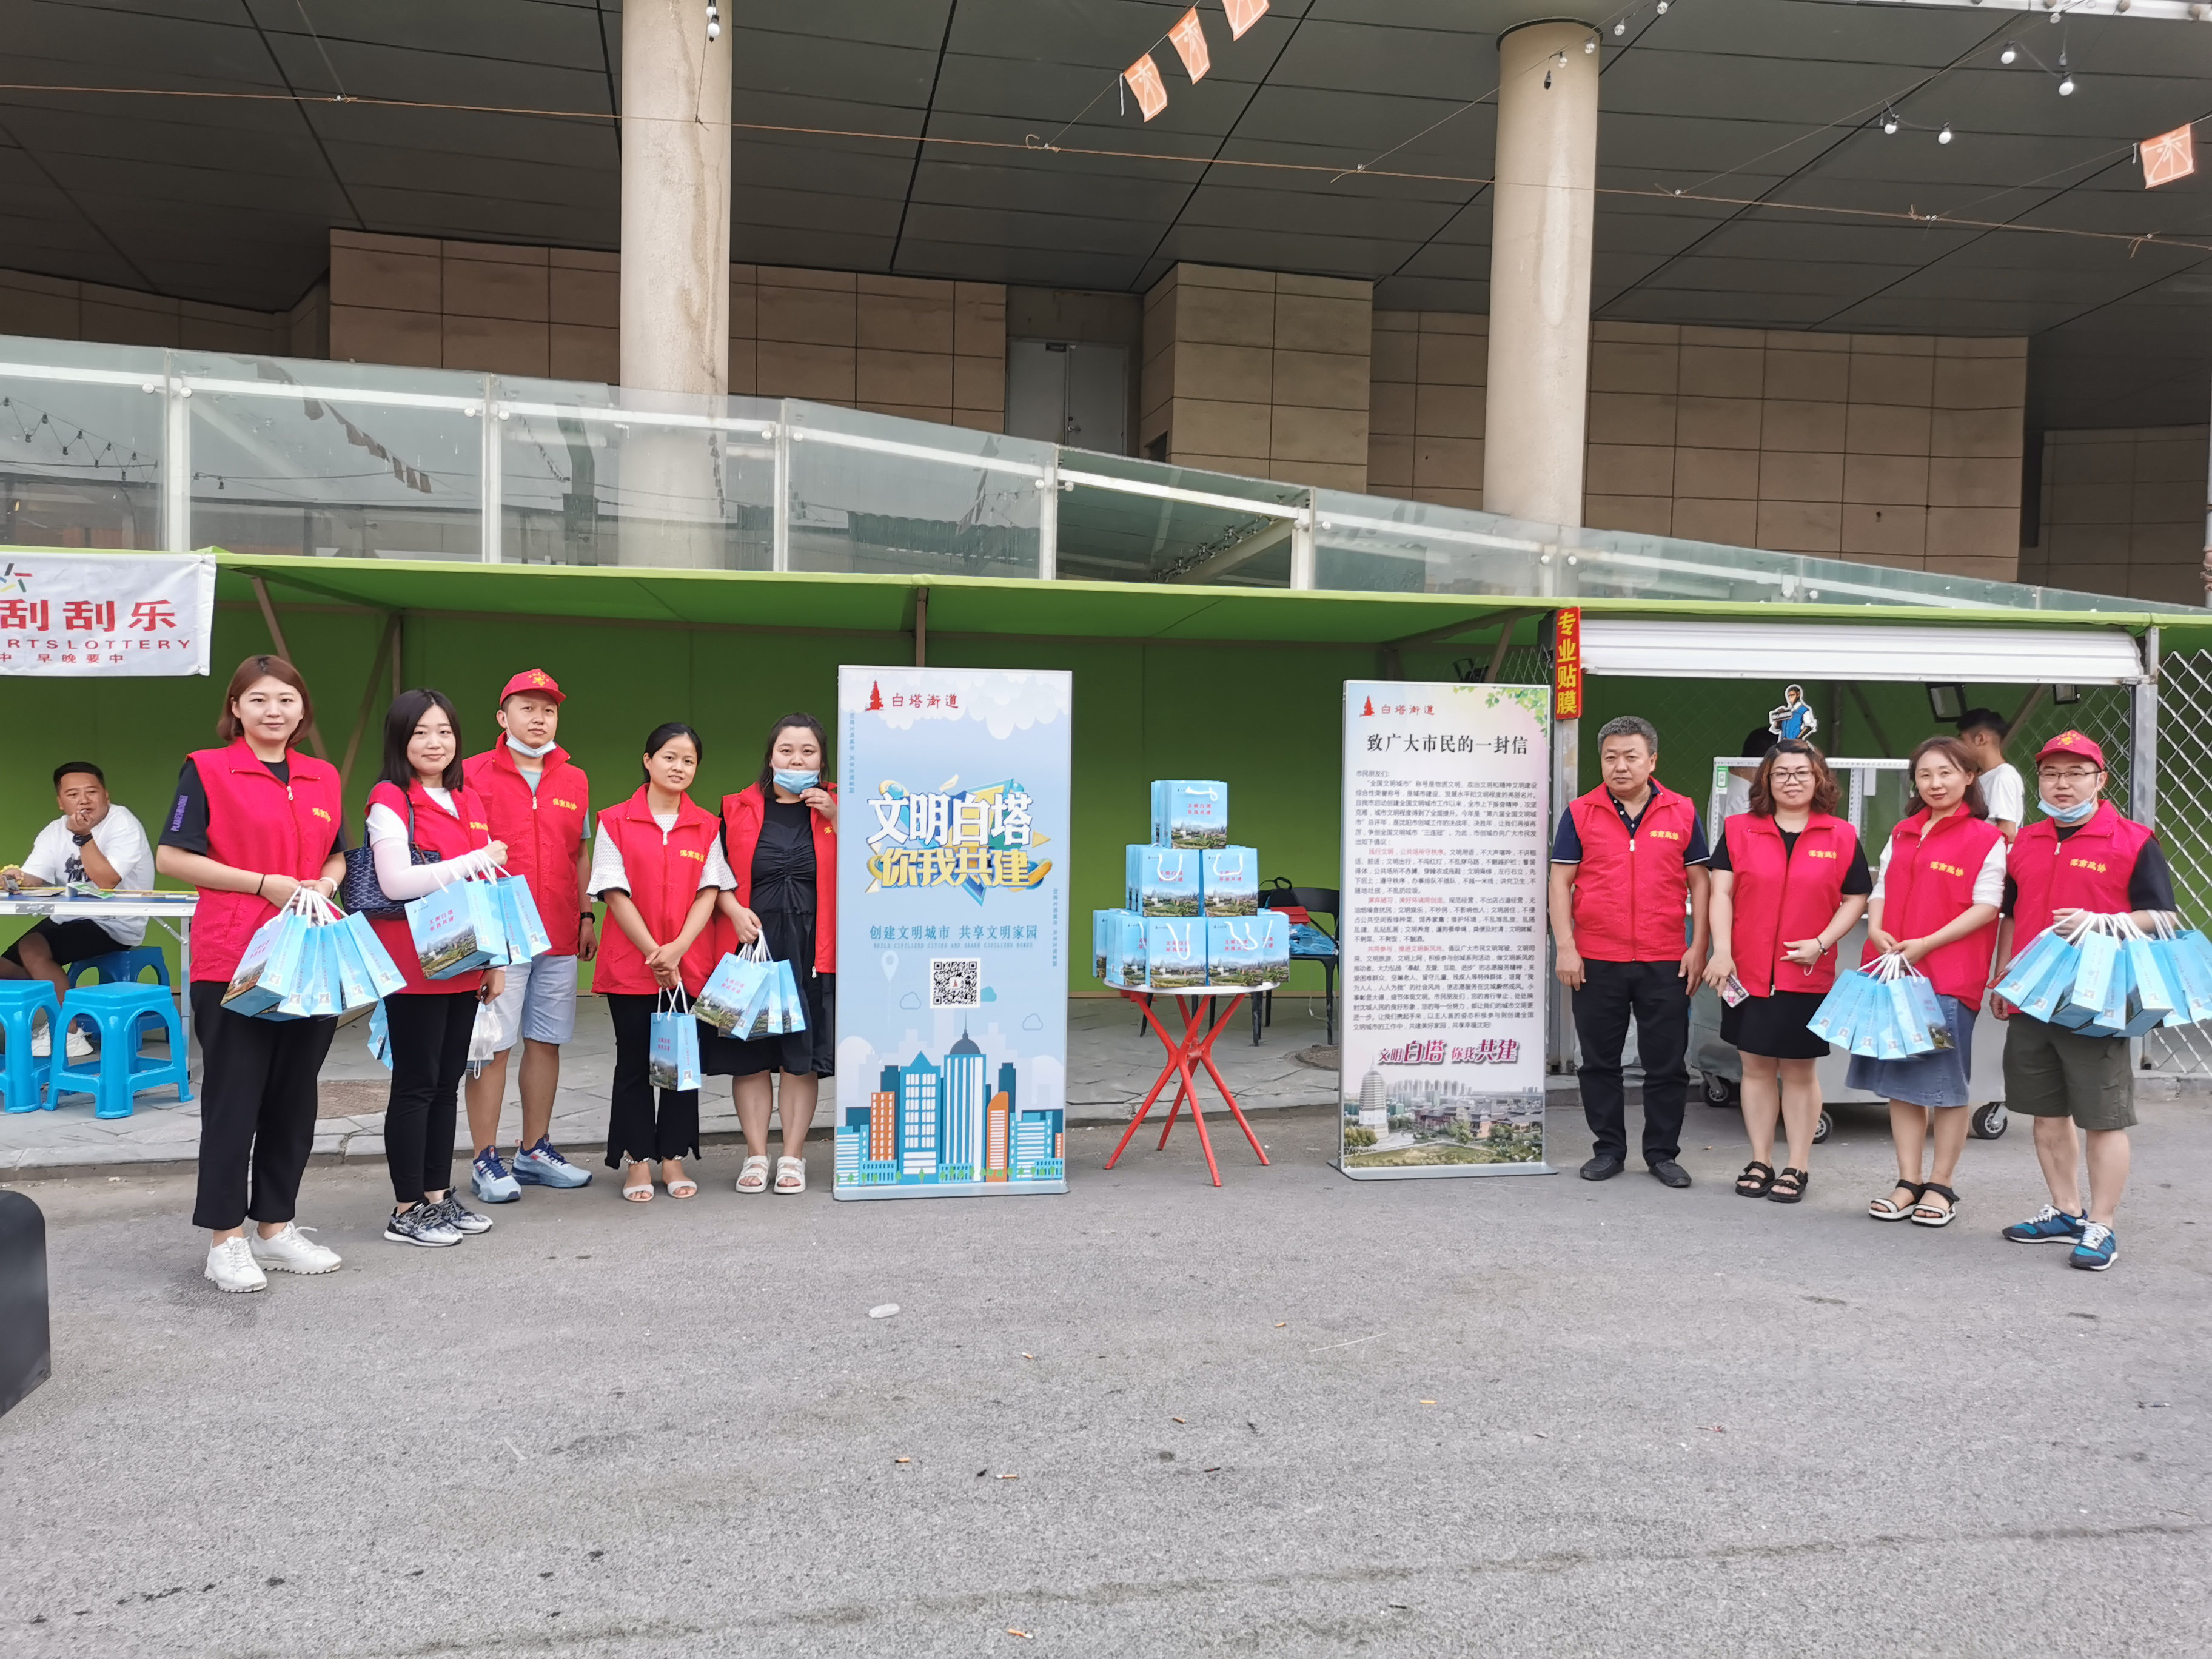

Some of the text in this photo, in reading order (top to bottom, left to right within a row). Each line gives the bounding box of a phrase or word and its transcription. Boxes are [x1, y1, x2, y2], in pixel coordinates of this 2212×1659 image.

[0, 598, 177, 632] 刮刮乐
[36, 653, 124, 664] 早晚要中
[1557, 611, 1577, 714] 专业贴膜
[891, 692, 959, 709] 白塔街道
[1381, 703, 1435, 716] 白塔街道
[1367, 732, 1529, 755] 致广大市民的一封信
[867, 791, 1033, 846] 文明白塔
[880, 847, 1031, 888] 你我共建
[870, 924, 1037, 940] 创建文明城市 共享文明家园
[1378, 1039, 1520, 1064] 文明白塔 你我共建
